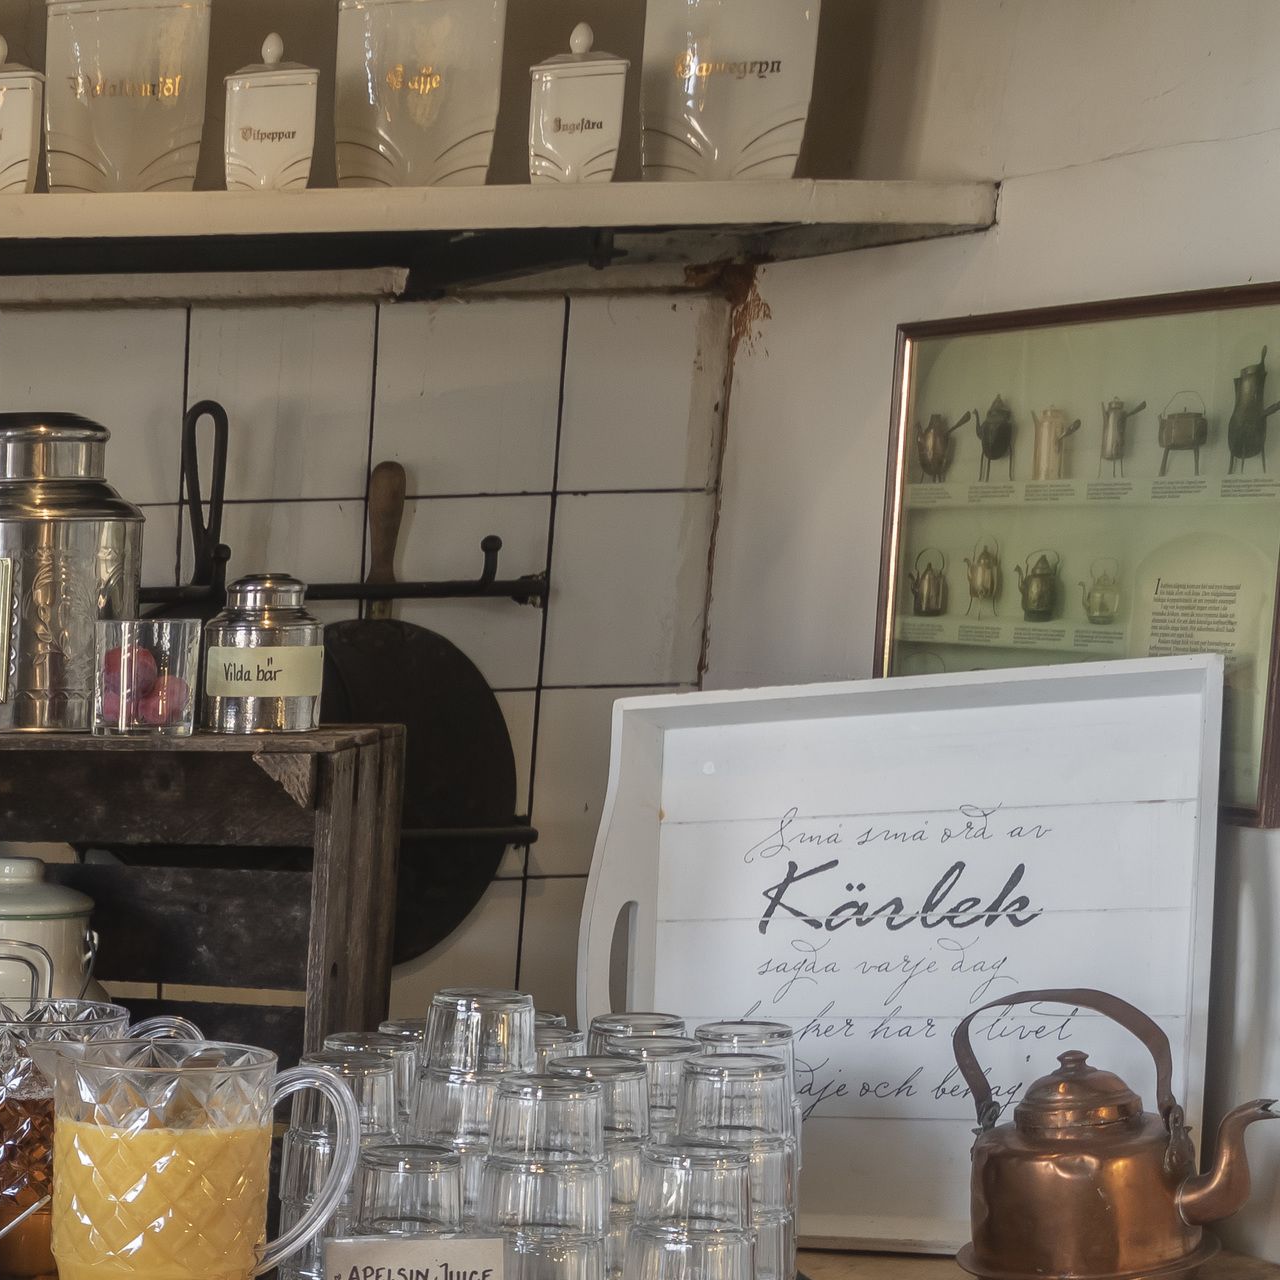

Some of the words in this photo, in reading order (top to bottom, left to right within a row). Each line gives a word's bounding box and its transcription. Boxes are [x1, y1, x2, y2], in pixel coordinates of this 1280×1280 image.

[223, 661, 252, 682] Vilda
[256, 656, 283, 682] bär
[743, 806, 842, 864] Små
[856, 820, 929, 846] små
[940, 801, 1003, 844] ord
[1006, 823, 1053, 840] av
[758, 859, 1044, 935] Kärlek
[757, 937, 840, 1004] sagda
[854, 947, 938, 1006] varje
[936, 936, 1019, 1004] dag
[869, 1005, 937, 1041] har
[975, 1000, 1080, 1041] livet
[859, 1065, 924, 1098] och
